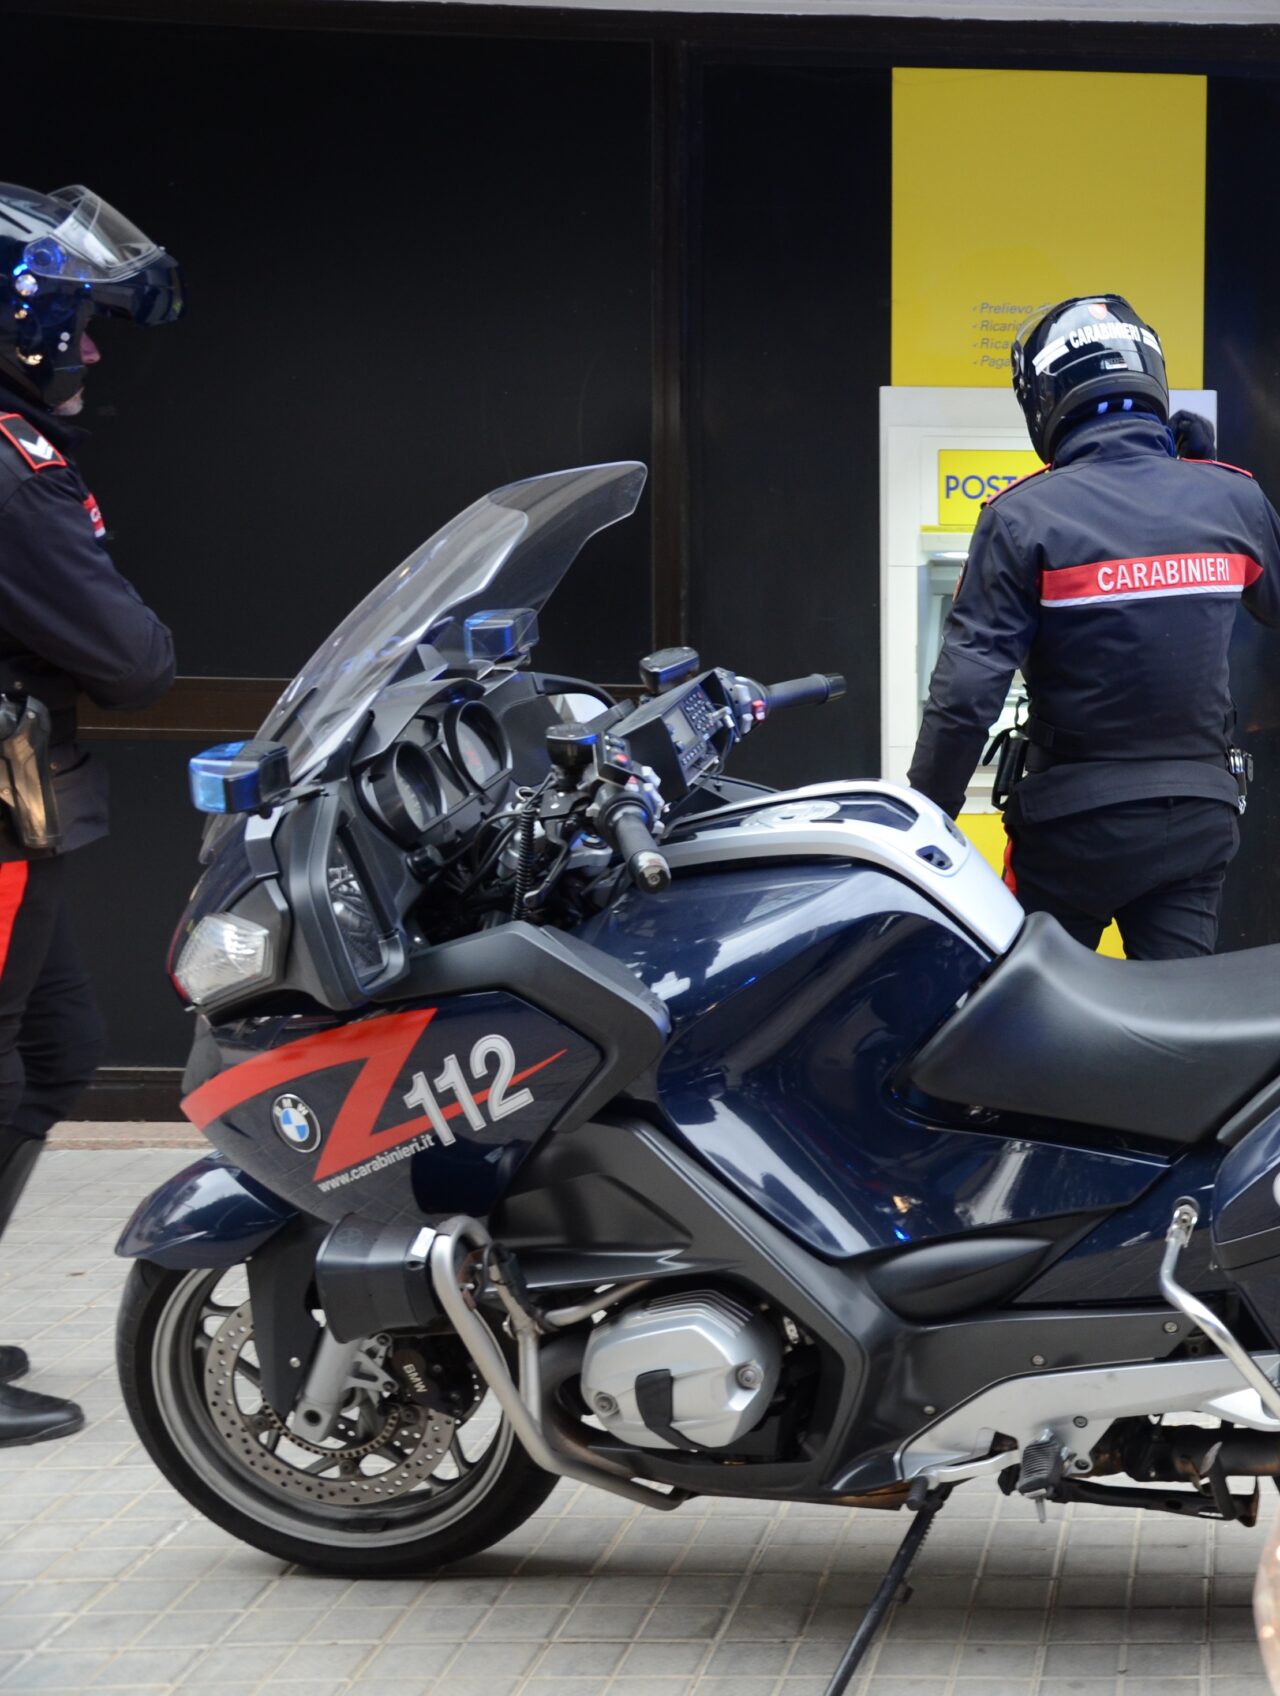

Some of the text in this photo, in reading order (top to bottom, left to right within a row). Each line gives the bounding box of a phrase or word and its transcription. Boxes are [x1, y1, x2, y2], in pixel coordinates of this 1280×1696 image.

[980, 302, 1034, 314] Prelievo
[1069, 322, 1141, 349] CARABINIERI
[1097, 558, 1230, 592] CARABINIERI
[403, 1033, 535, 1147] 112
[317, 1133, 435, 1193] www.carabinieri.it
[402, 1363, 428, 1393] BMW
